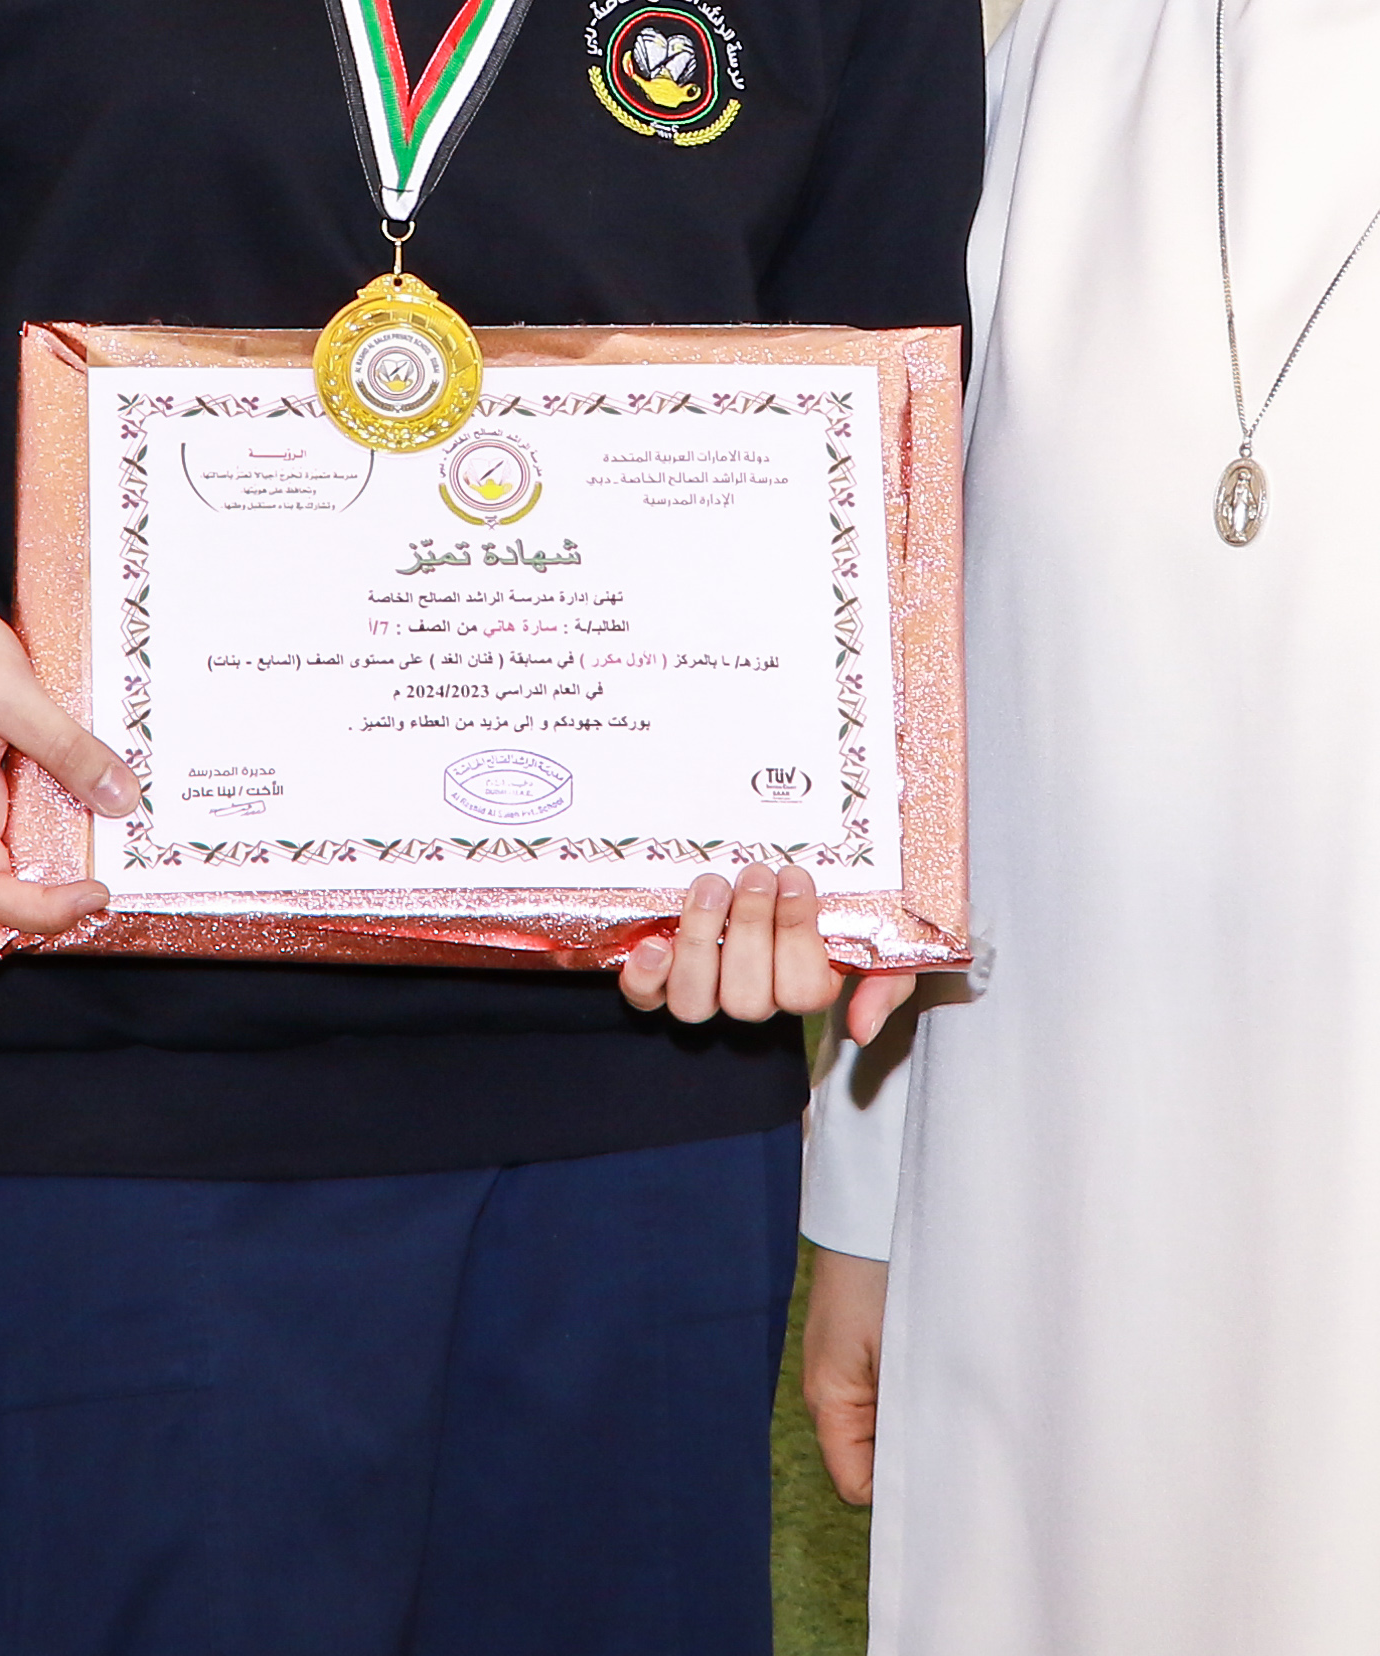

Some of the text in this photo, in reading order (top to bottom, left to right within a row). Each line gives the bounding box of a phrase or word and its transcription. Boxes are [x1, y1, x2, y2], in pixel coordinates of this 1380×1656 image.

[603, 451, 651, 463] المتحدة
[655, 451, 694, 464] العربية
[744, 451, 769, 464] دولة
[586, 477, 611, 486] دبي
[621, 472, 665, 483] الخاصة
[668, 472, 708, 486] الصالح
[713, 472, 746, 485] الراشد
[750, 473, 788, 485] مدرسة
[643, 493, 734, 508] الإدارة المدرسية
[481, 538, 581, 573] شهادة
[368, 590, 413, 603] الخاصة
[418, 592, 460, 608] الصالح
[466, 591, 504, 606] الراشد
[509, 589, 554, 606] مدرسة
[560, 591, 588, 605] إدارة
[408, 619, 450, 632] الصف
[457, 622, 477, 636] من
[483, 620, 515, 638] هاني
[523, 619, 557, 636] سارة
[307, 653, 343, 665] الصف
[350, 654, 394, 668] مستوى
[399, 653, 423, 670] على
[441, 653, 462, 664] الغد
[468, 651, 493, 668] فنان
[510, 651, 553, 667] مسابقة
[557, 651, 574, 670] في
[592, 654, 622, 667] مكرر
[627, 651, 656, 667] الأول
[674, 654, 717, 669] بالمركز
[407, 684, 489, 698] 2024/2023
[495, 683, 547, 701] الدراسي
[553, 683, 580, 700] العام
[586, 681, 603, 701] في
[359, 716, 404, 732] والتميز
[410, 715, 449, 729] العطاء
[455, 718, 474, 731] من
[480, 716, 508, 731] مزيد
[514, 715, 533, 733] إلى
[553, 716, 603, 732] جهودكم
[608, 716, 650, 731] بوركت
[188, 767, 275, 779] مديرة المدرسة
[766, 766, 796, 783] TÜV
[182, 787, 214, 801] عادل
[217, 786, 236, 799] لينا
[246, 781, 283, 796] الأخت
